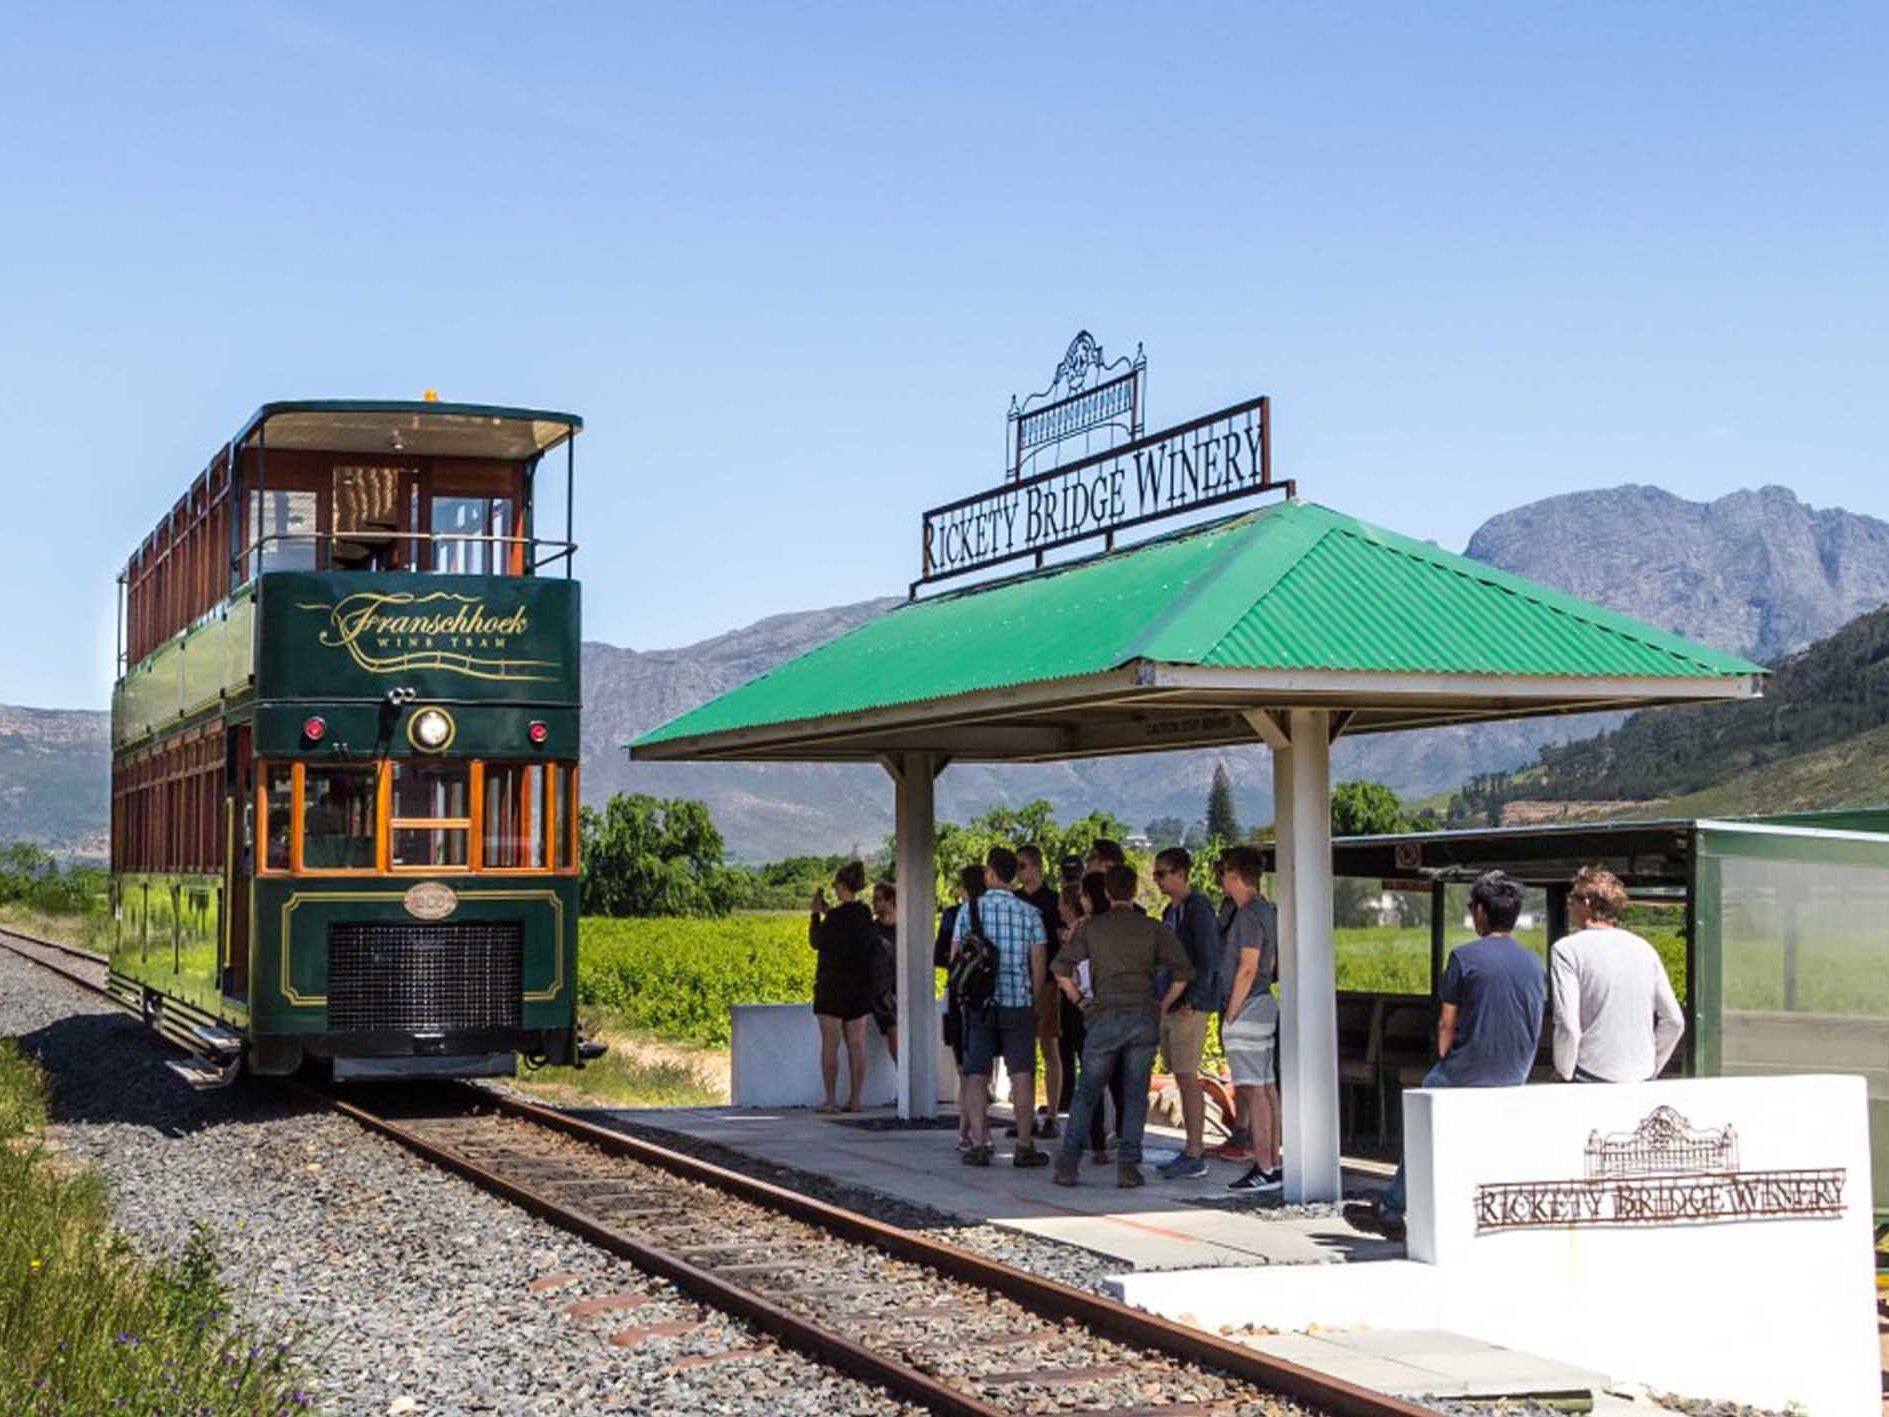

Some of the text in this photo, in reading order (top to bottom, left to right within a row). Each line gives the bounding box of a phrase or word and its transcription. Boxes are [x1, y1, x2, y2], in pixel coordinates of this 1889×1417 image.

[923, 424, 1263, 570] RICKETY BRIDGE WINERY
[325, 595, 527, 644] Franschhoek
[377, 637, 506, 648] WINE TRAM
[1480, 1177, 1845, 1222] RICKETY BRIDGE WINERY
